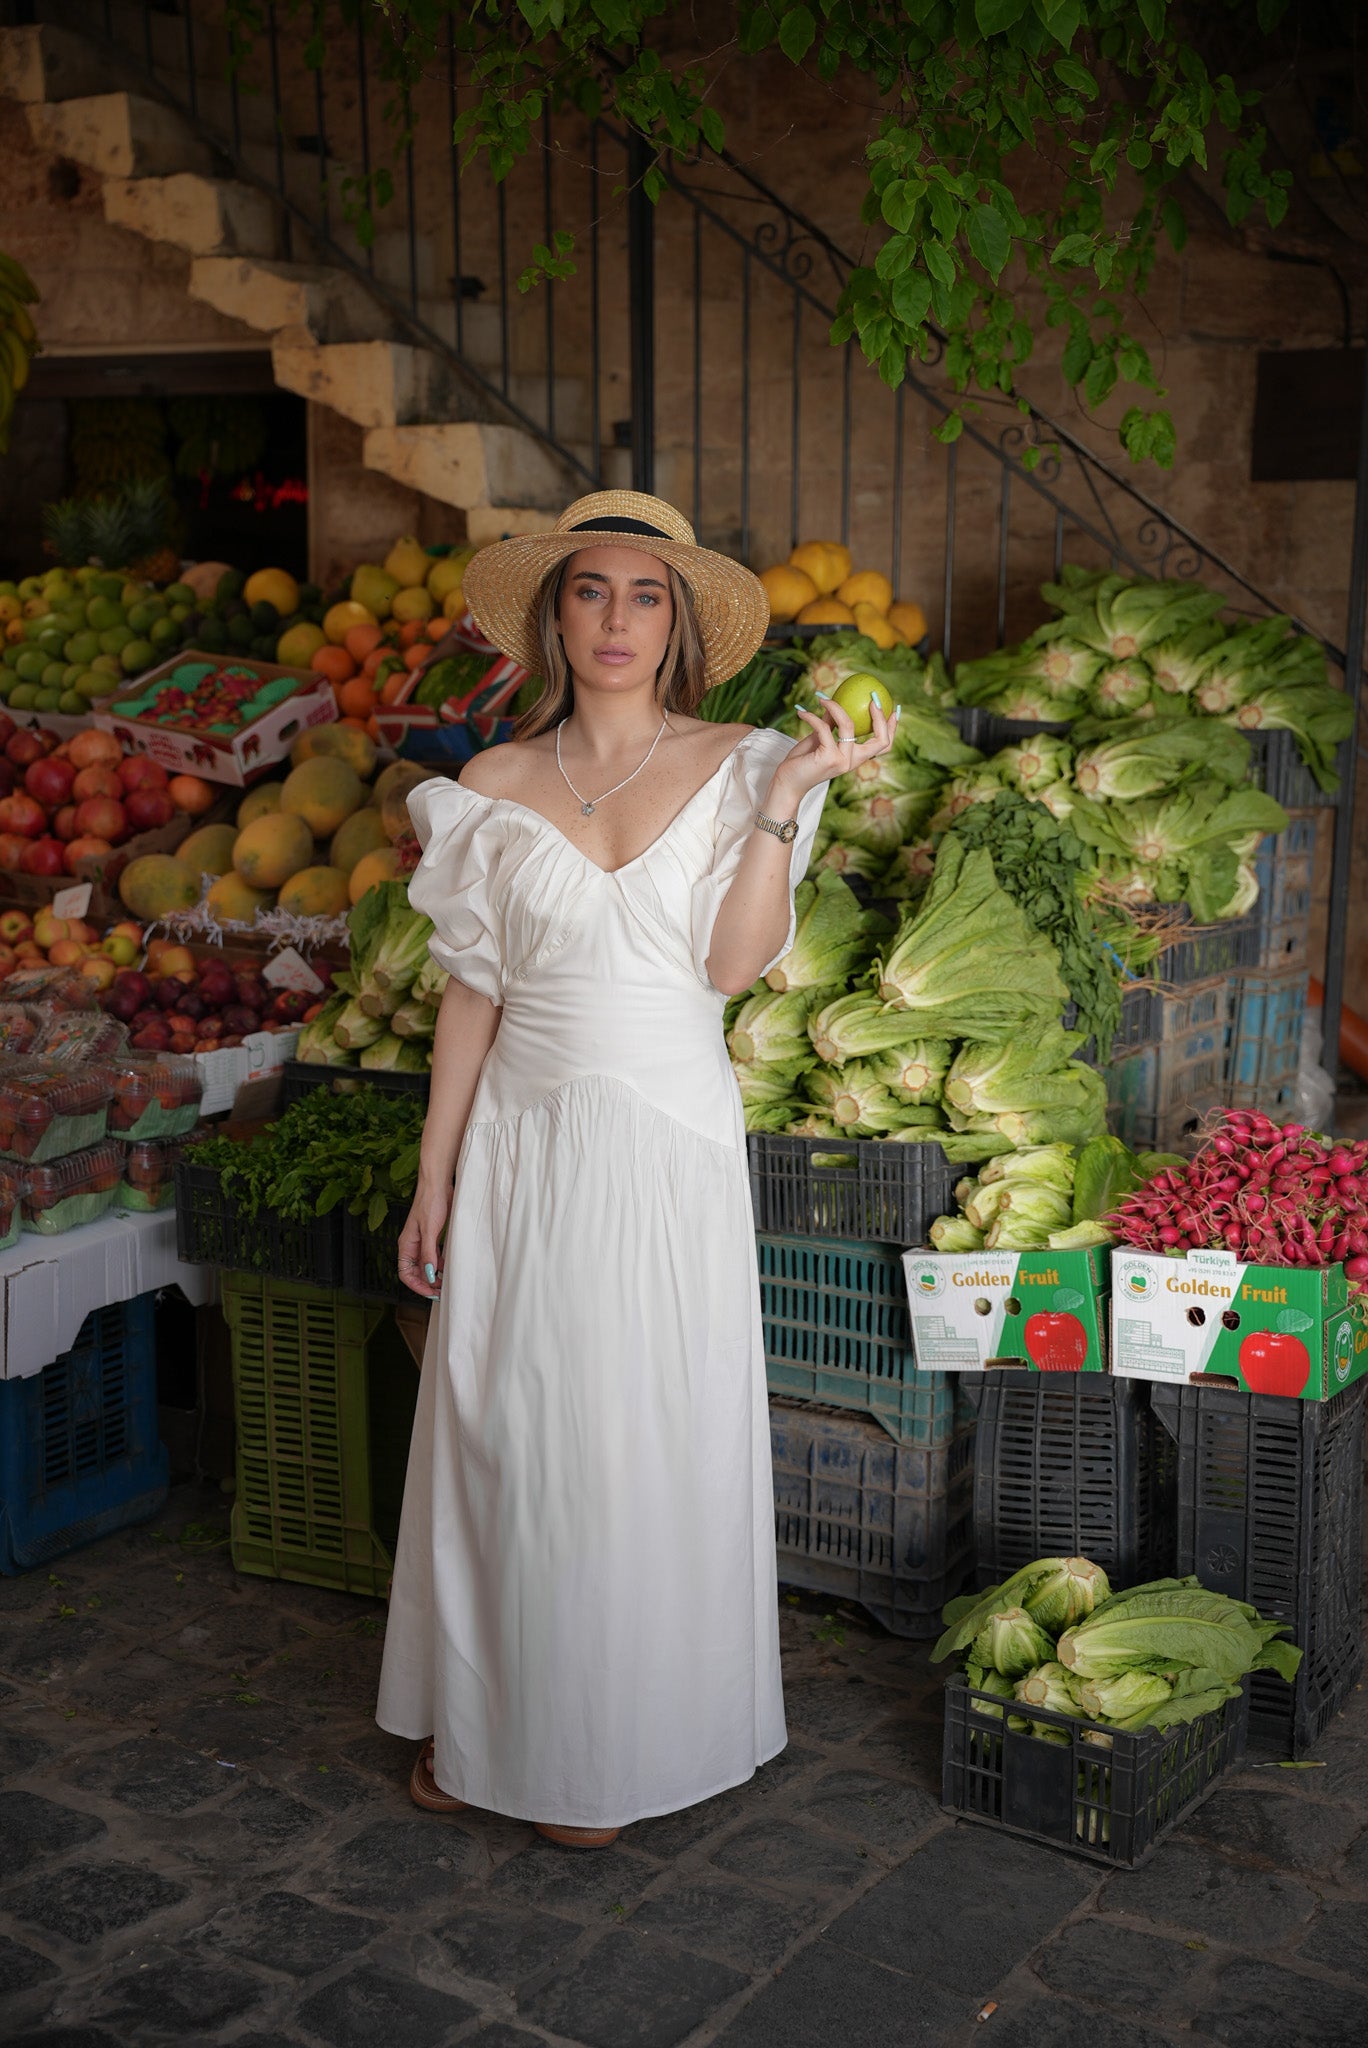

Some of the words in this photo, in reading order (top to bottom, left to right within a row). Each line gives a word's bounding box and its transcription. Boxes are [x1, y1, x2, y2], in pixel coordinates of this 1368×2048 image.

[1123, 1262, 1152, 1273] GOLDEN
[1192, 1254, 1230, 1267] Türkiye
[952, 1271, 1011, 1287] Golden
[1018, 1268, 1060, 1285] Fruit
[1166, 1277, 1231, 1298] Golden
[1241, 1284, 1288, 1304] Fruit
